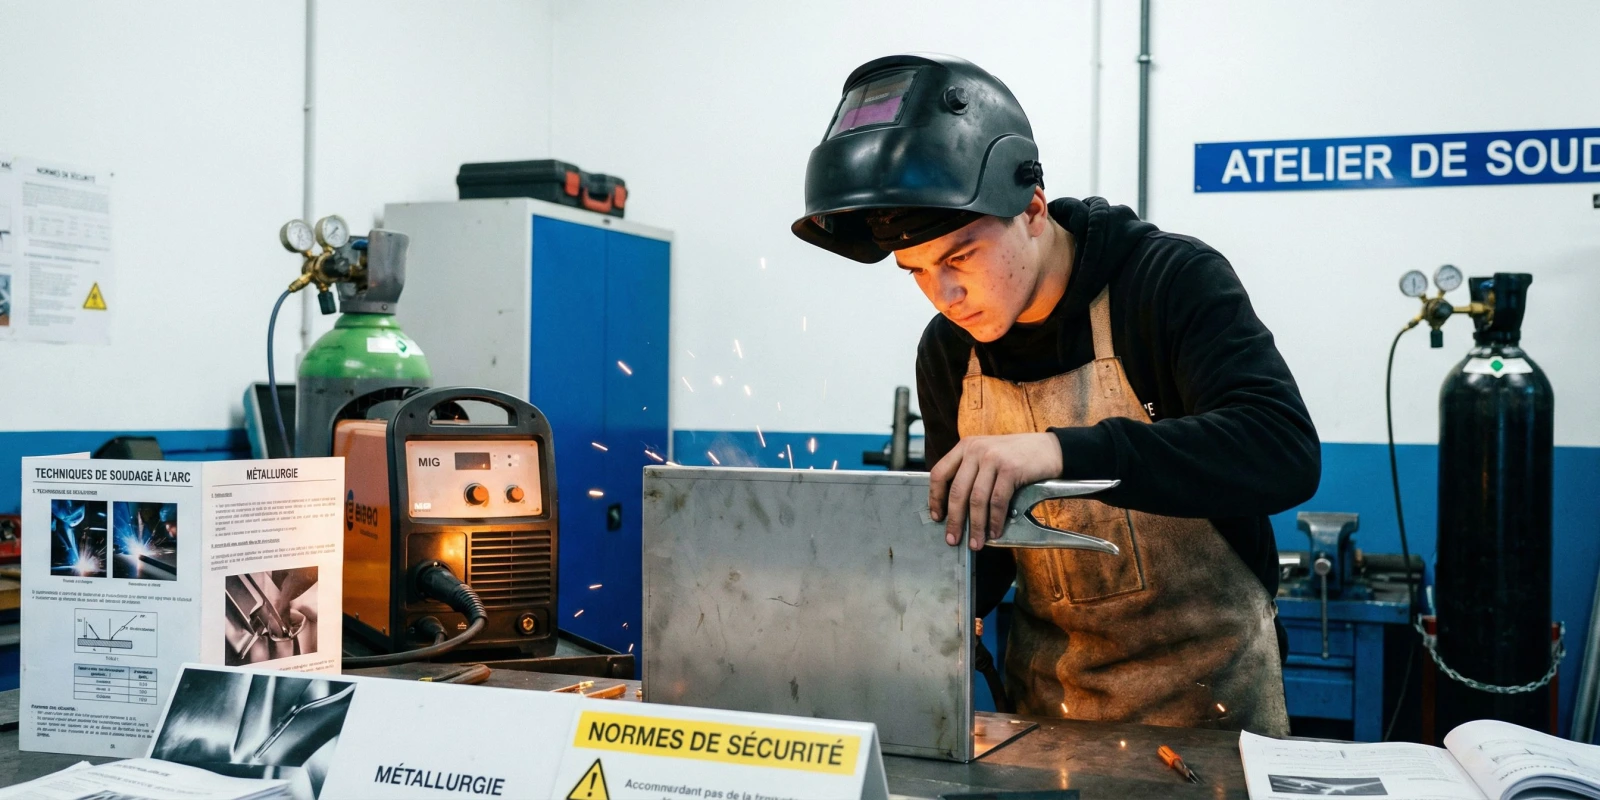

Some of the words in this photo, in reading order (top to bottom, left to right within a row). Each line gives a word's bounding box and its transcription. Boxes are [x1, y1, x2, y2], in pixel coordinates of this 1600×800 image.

[1221, 144, 1394, 185] ATELIER
[1411, 141, 1467, 179] DE
[1485, 137, 1600, 177] SOUD
[418, 457, 440, 467] MIG
[35, 467, 93, 480] TECHNIQUES
[95, 469, 107, 481] DE
[110, 469, 153, 482] SOUDAGE
[155, 468, 162, 482] À
[164, 470, 191, 483] L'ARC
[246, 467, 298, 480] MÉTALLURGIE
[588, 721, 684, 750] NORMES
[690, 731, 721, 753] DE
[727, 730, 845, 766] SÉCURITÉ
[374, 762, 506, 797] MÉTALLURGIE
[704, 789, 723, 800] pas
[726, 789, 740, 800] de
[742, 791, 752, 800] la
